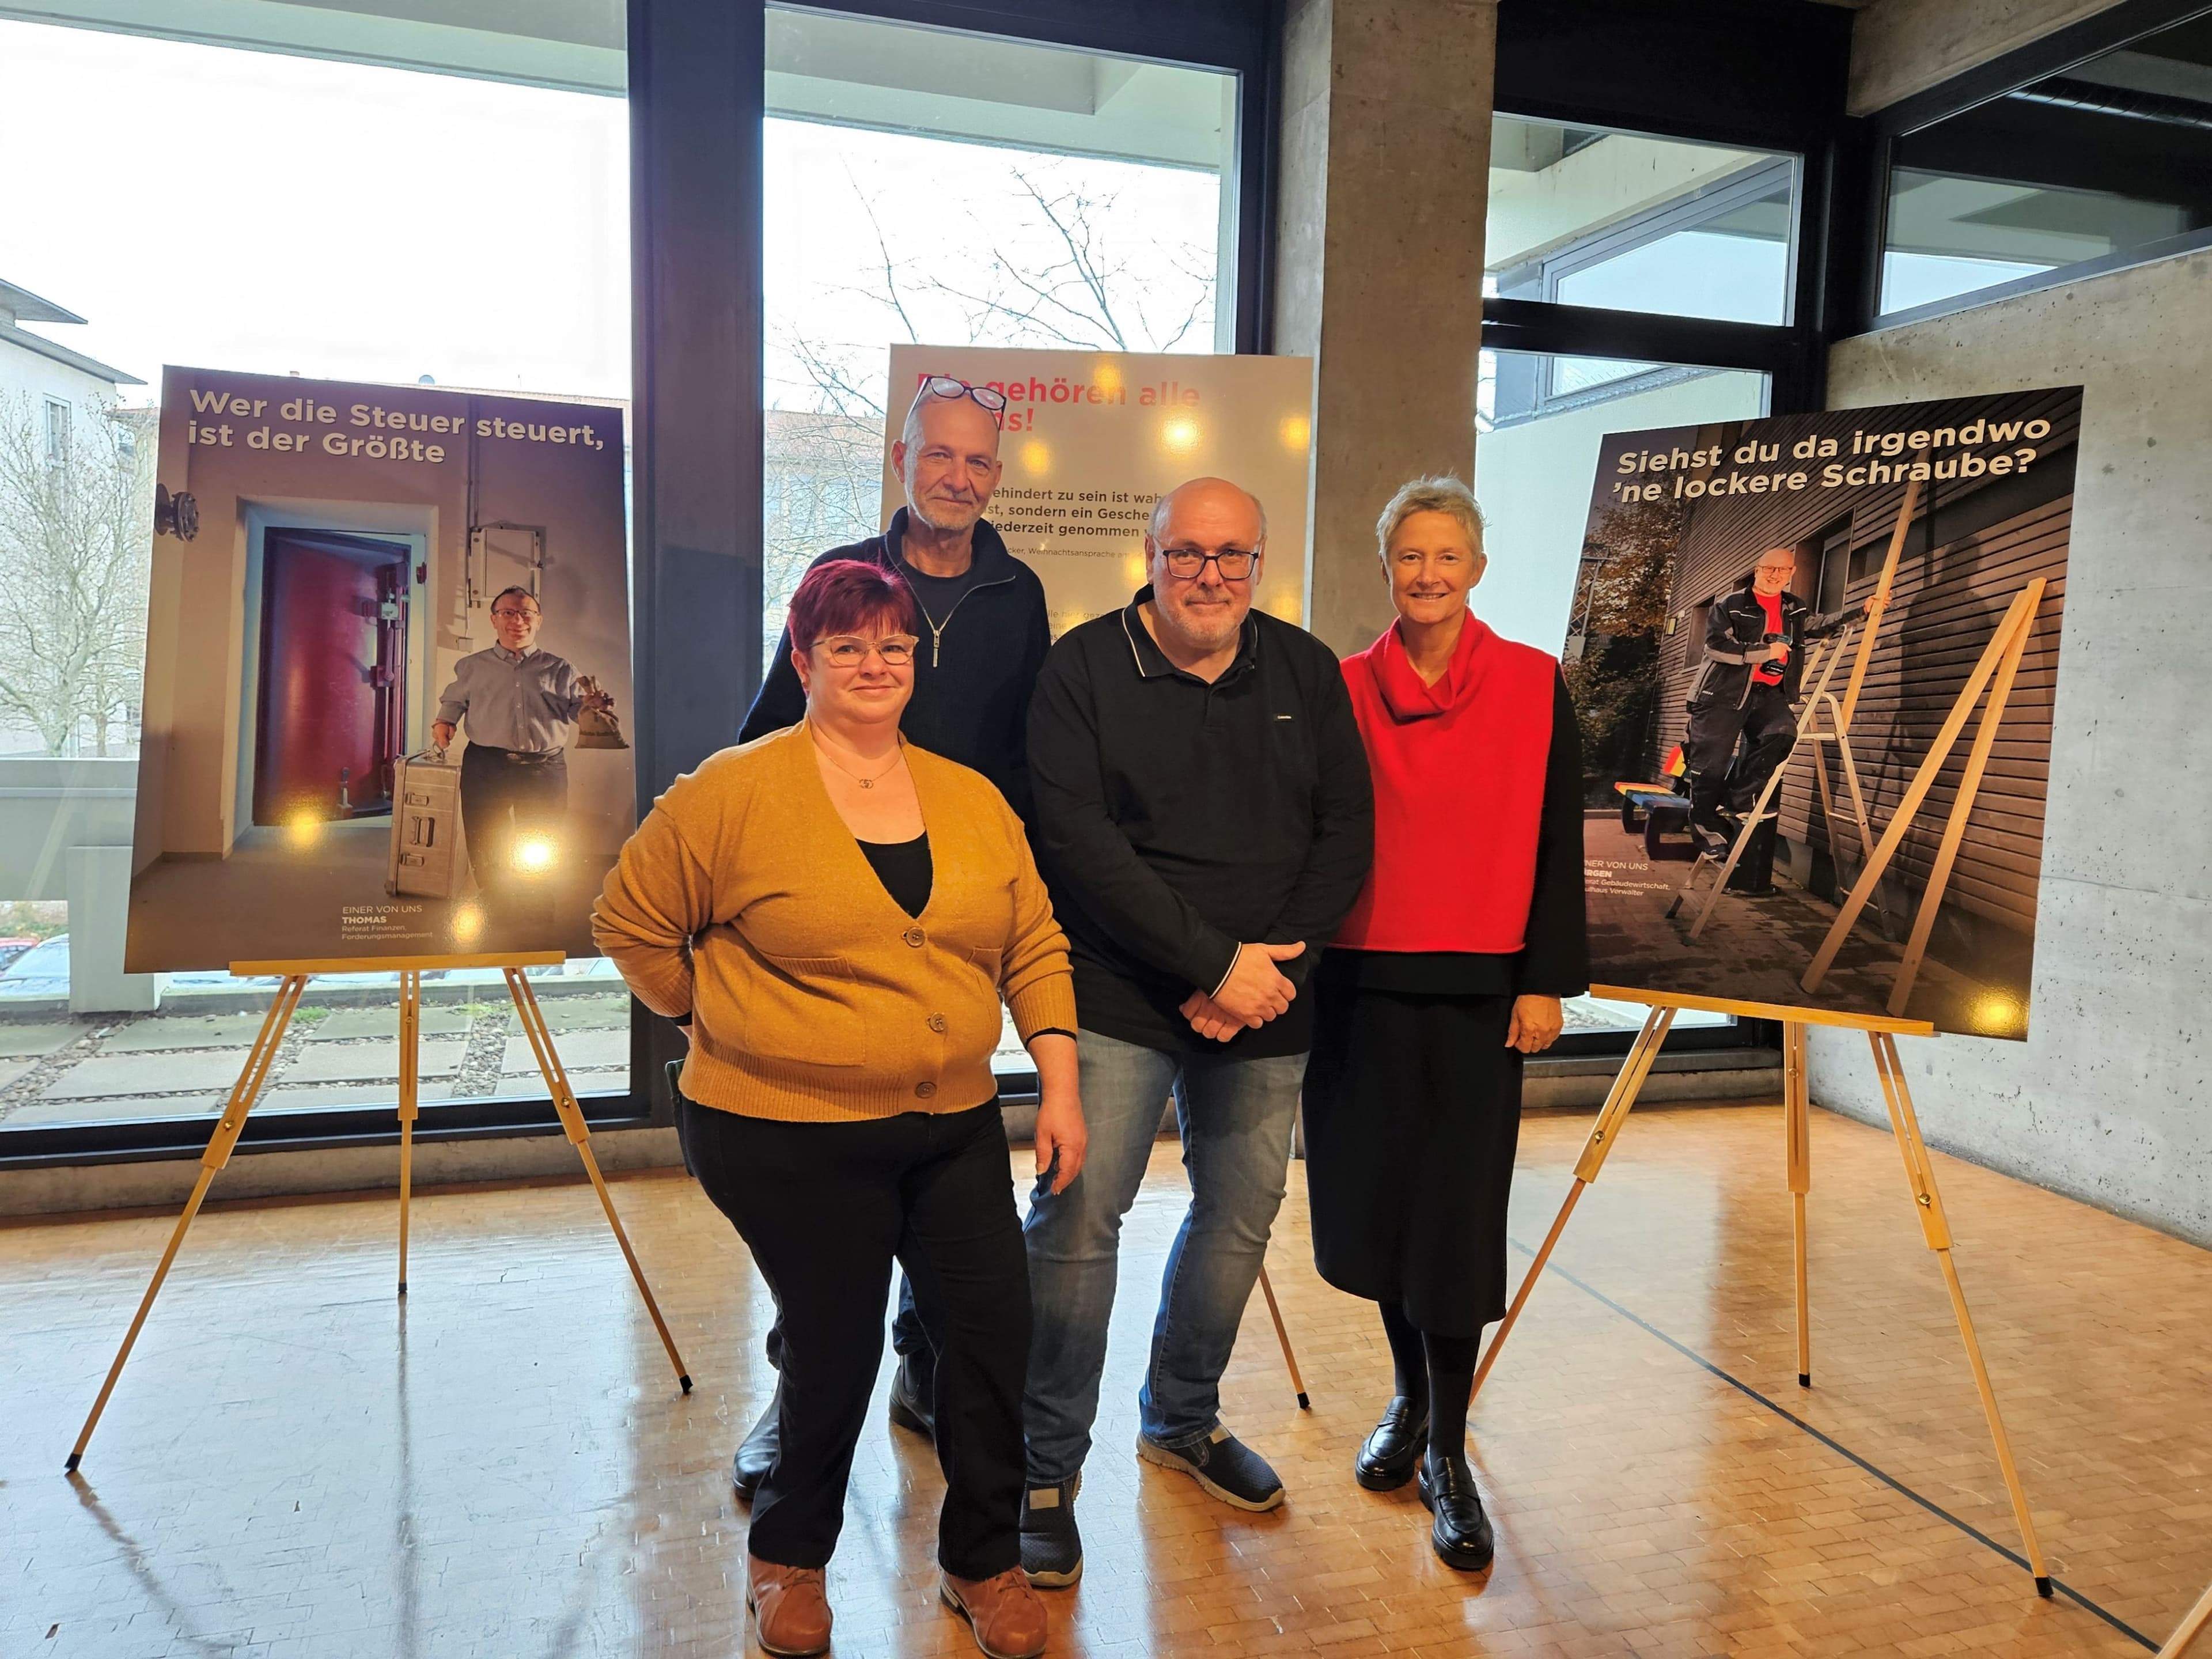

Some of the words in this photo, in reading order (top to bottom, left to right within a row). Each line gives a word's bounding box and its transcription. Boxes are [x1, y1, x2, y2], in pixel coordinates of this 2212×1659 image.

[986, 377, 1126, 405] gehören
[1139, 381, 1200, 406] alle
[190, 389, 267, 418] Wer
[281, 398, 337, 424] die
[350, 404, 465, 434] Steuer
[476, 417, 604, 450] steuert,
[188, 421, 233, 447] ist
[247, 426, 310, 452] der
[323, 433, 445, 463] Größte
[1617, 445, 1722, 474] Siehst
[1734, 440, 1780, 464] du
[1793, 434, 1839, 460] da
[1853, 419, 2051, 456] irgendwo
[1674, 471, 1808, 499] lockere
[1821, 448, 2037, 487] Schraube?
[993, 487, 1053, 499] ehindert
[1057, 491, 1074, 500] zu
[1079, 491, 1107, 502] sein
[1112, 491, 1129, 502] ist
[1134, 493, 1162, 504] wah
[987, 504, 1003, 517] st,
[1009, 506, 1066, 517] sondern
[1071, 507, 1092, 518] ein
[1098, 509, 1150, 520] Gesche
[1059, 524, 1139, 537] genommen
[1585, 859, 1604, 868] NER
[1606, 861, 1627, 869] VON
[1628, 863, 1649, 871] UNS
[1584, 869, 1612, 878] RGEN
[1609, 888, 1644, 896] Verwalter
[343, 906, 373, 914] EINER
[402, 905, 423, 913] UNS
[342, 916, 388, 924] THOMAS
